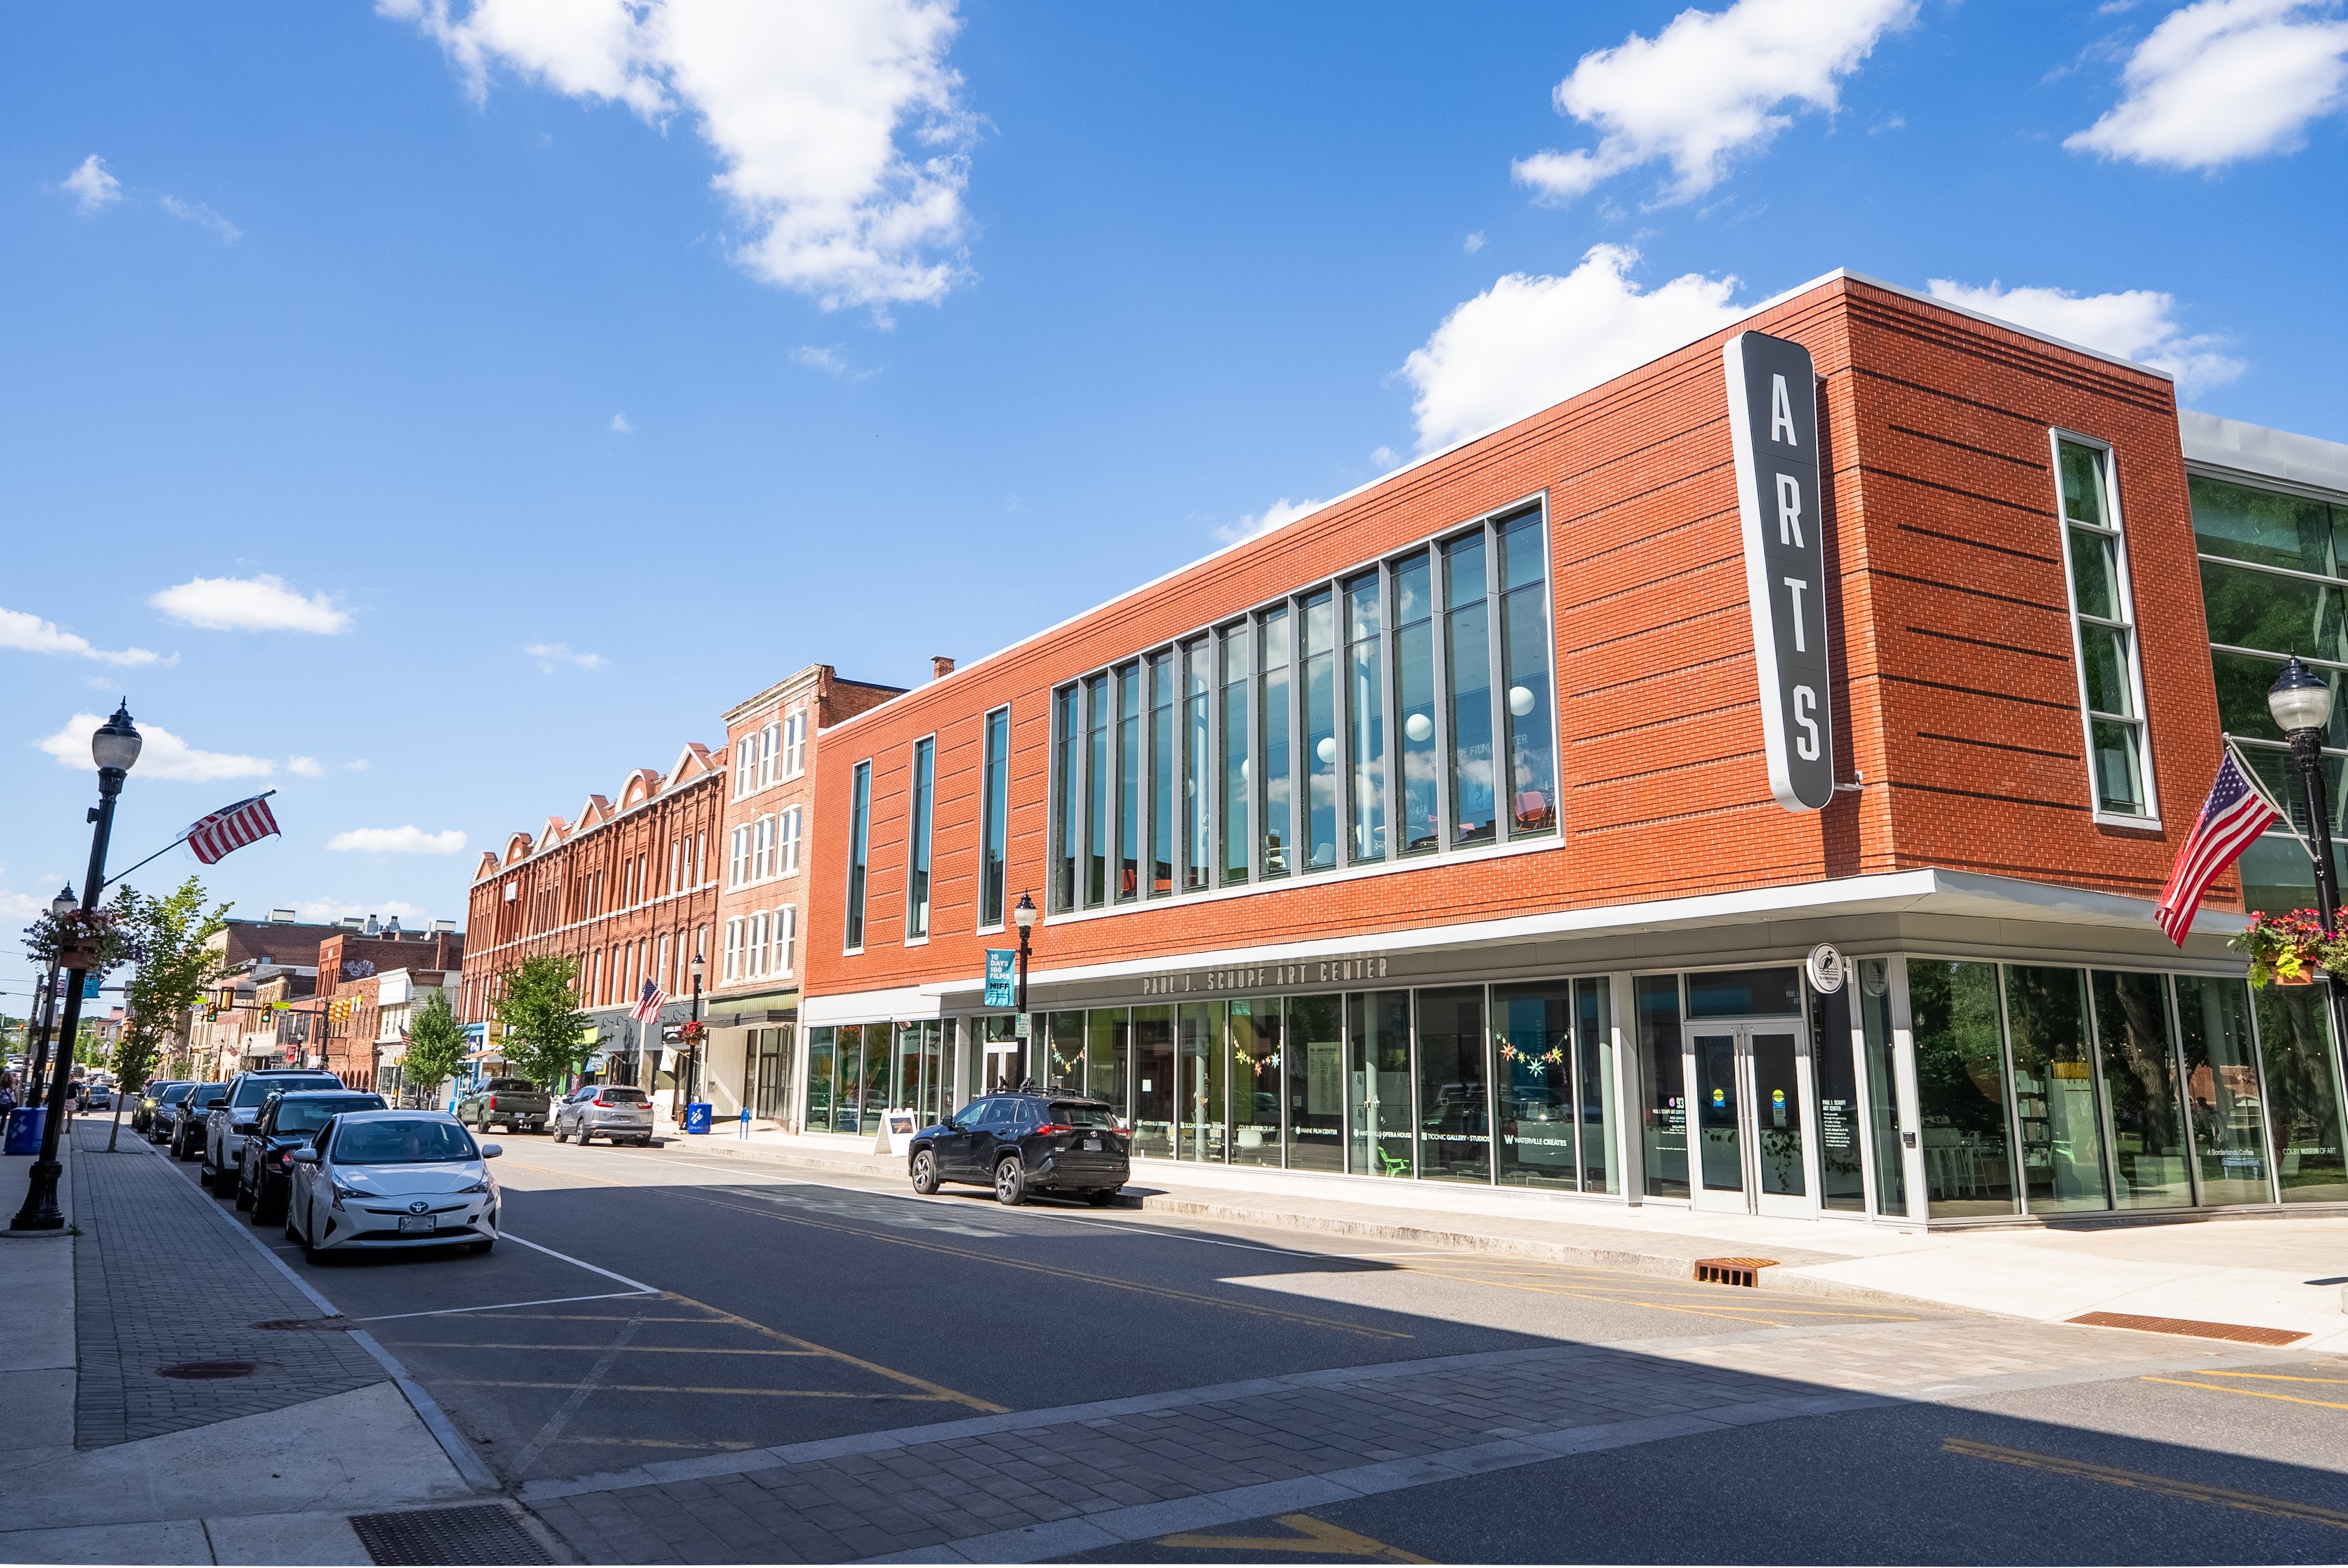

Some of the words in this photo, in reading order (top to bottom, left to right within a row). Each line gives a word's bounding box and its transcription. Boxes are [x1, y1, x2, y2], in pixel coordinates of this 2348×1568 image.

[1771, 373, 1822, 762] ARTS
[1144, 976, 1175, 995] PAUL
[1185, 974, 1197, 992] J.
[1208, 969, 1264, 990] SCHUPF
[1277, 965, 1306, 985] ART
[1320, 958, 1387, 982] CENTER
[1676, 1098, 1684, 1109] 93
[1469, 1135, 1490, 1143] STUDIOS
[1514, 1137, 1543, 1145] WATERVILLE
[1543, 1139, 1567, 1147] CREATES
